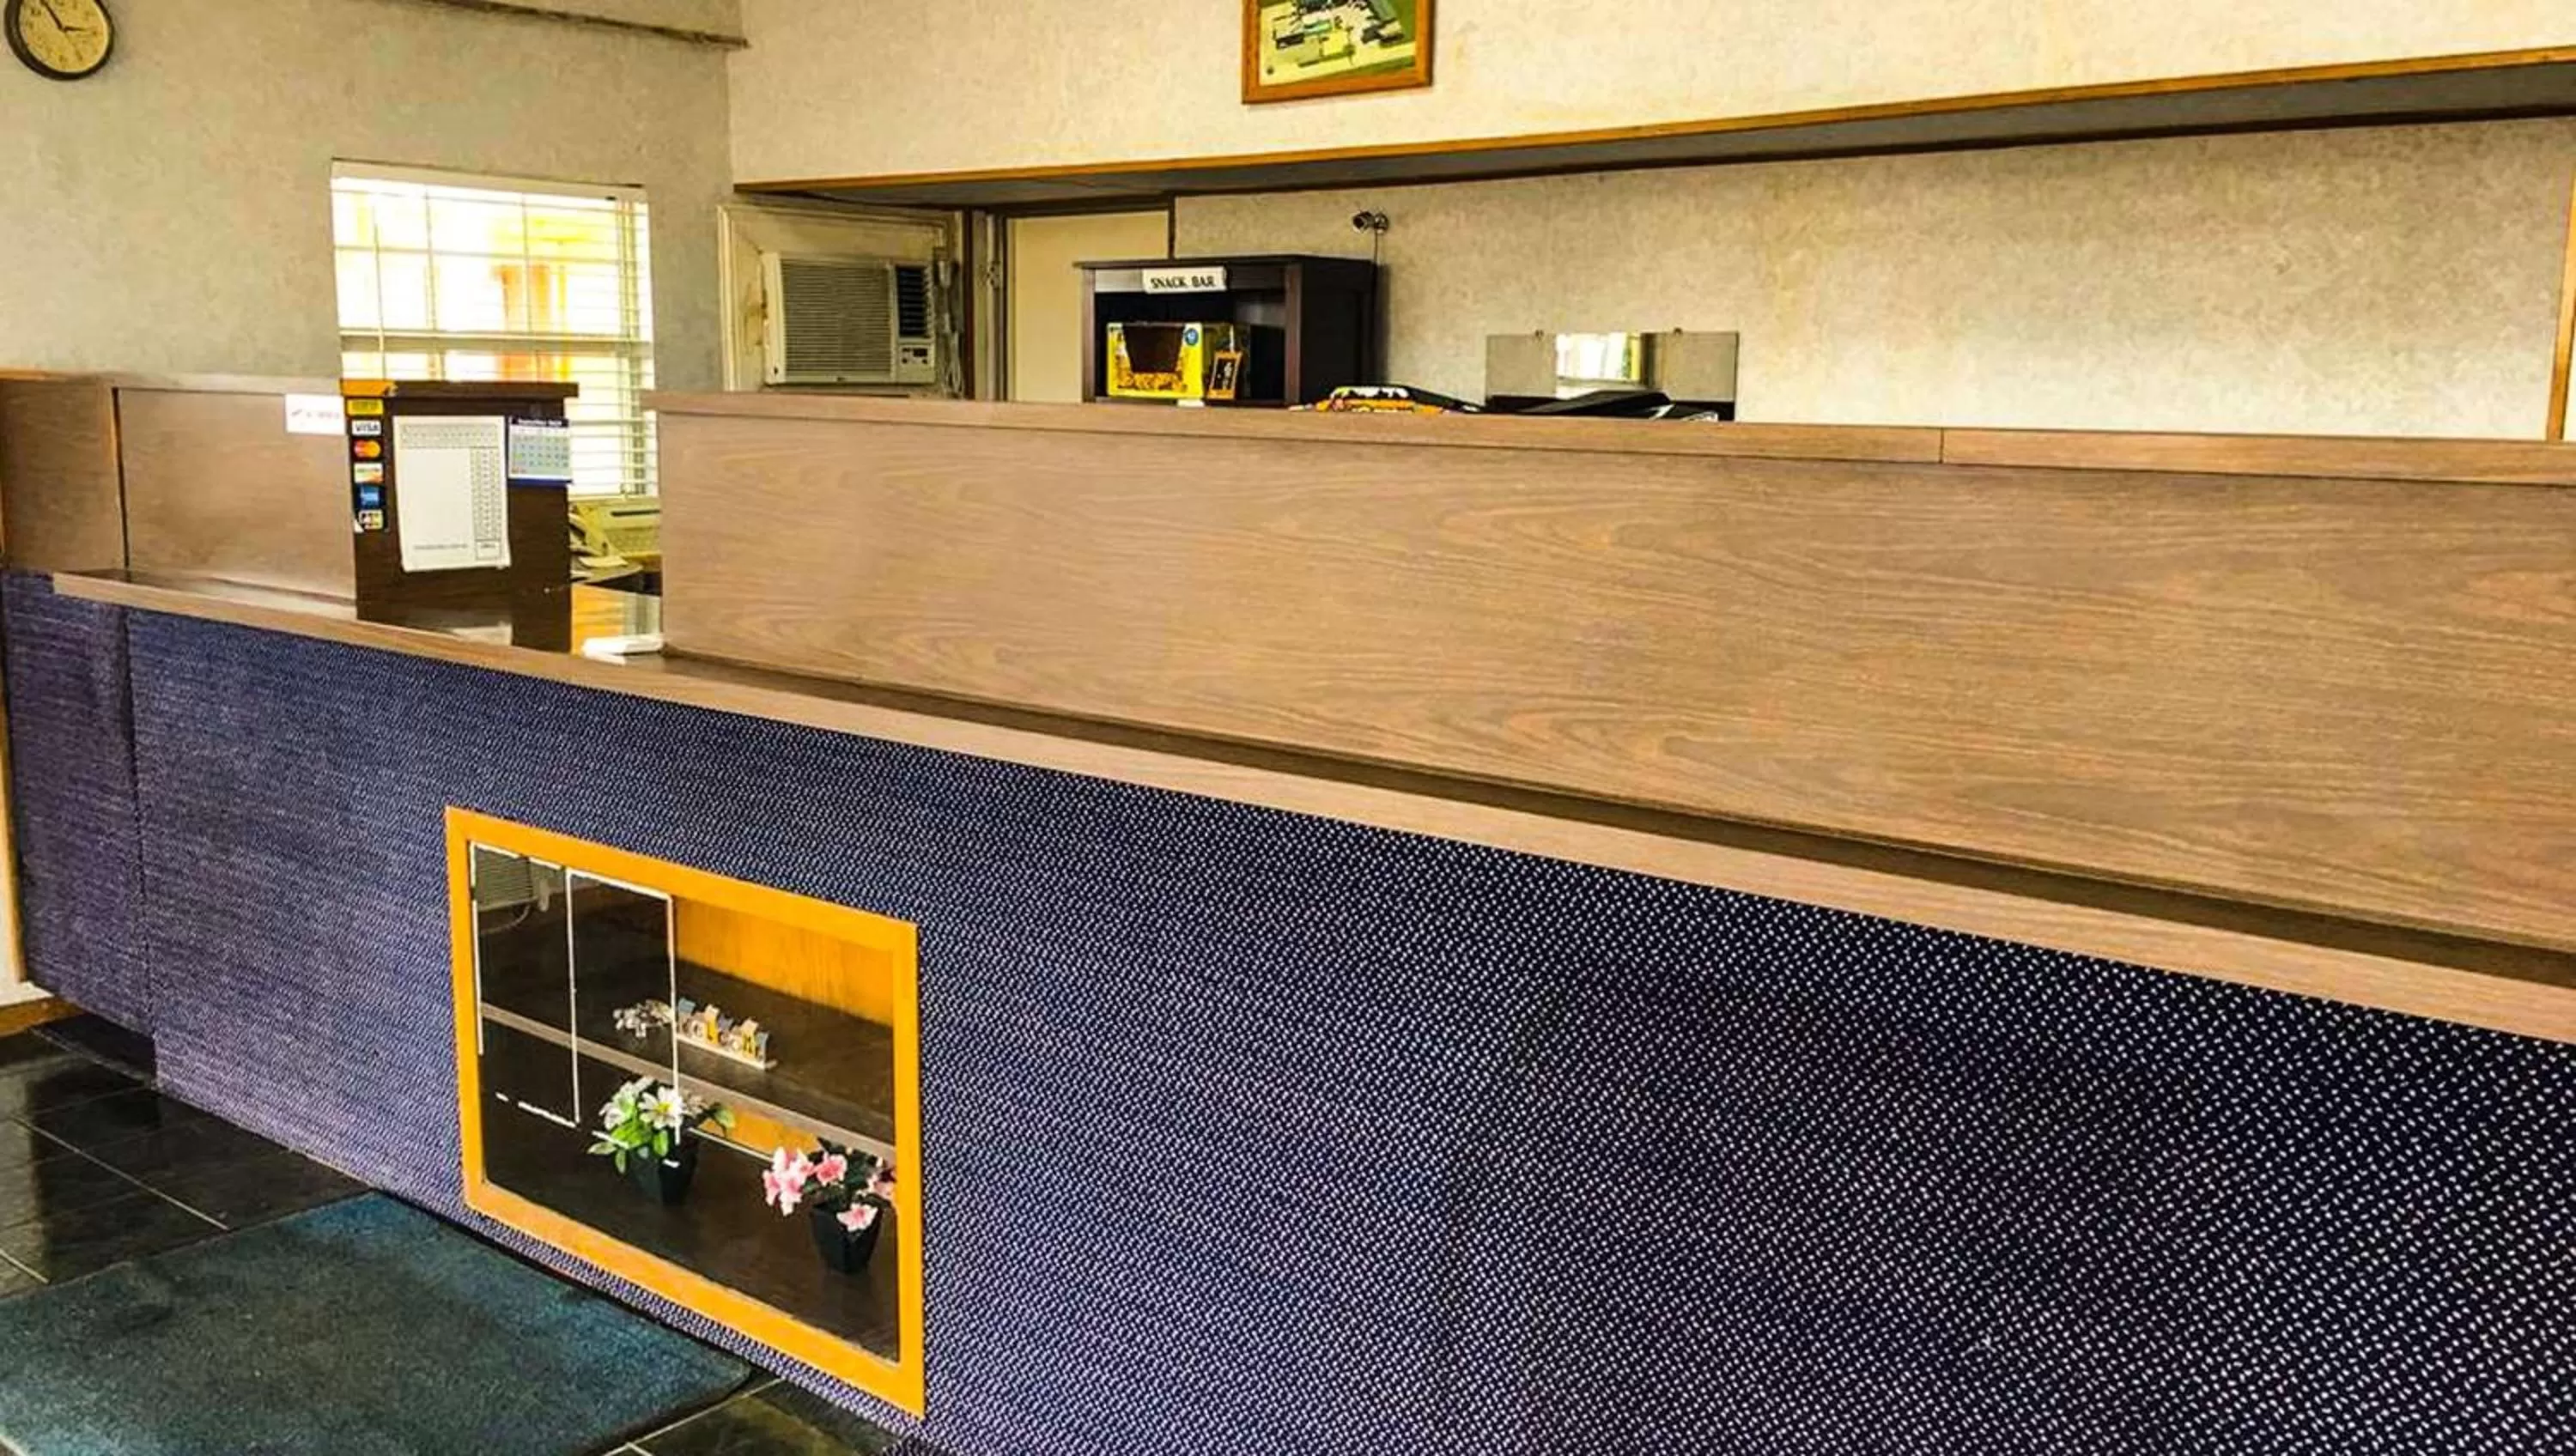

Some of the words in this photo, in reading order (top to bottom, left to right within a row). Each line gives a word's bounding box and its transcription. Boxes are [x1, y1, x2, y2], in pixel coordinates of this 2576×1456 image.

[1150, 276, 1188, 289] SNACK
[1191, 275, 1217, 288] BAR
[355, 422, 380, 434] VISA
